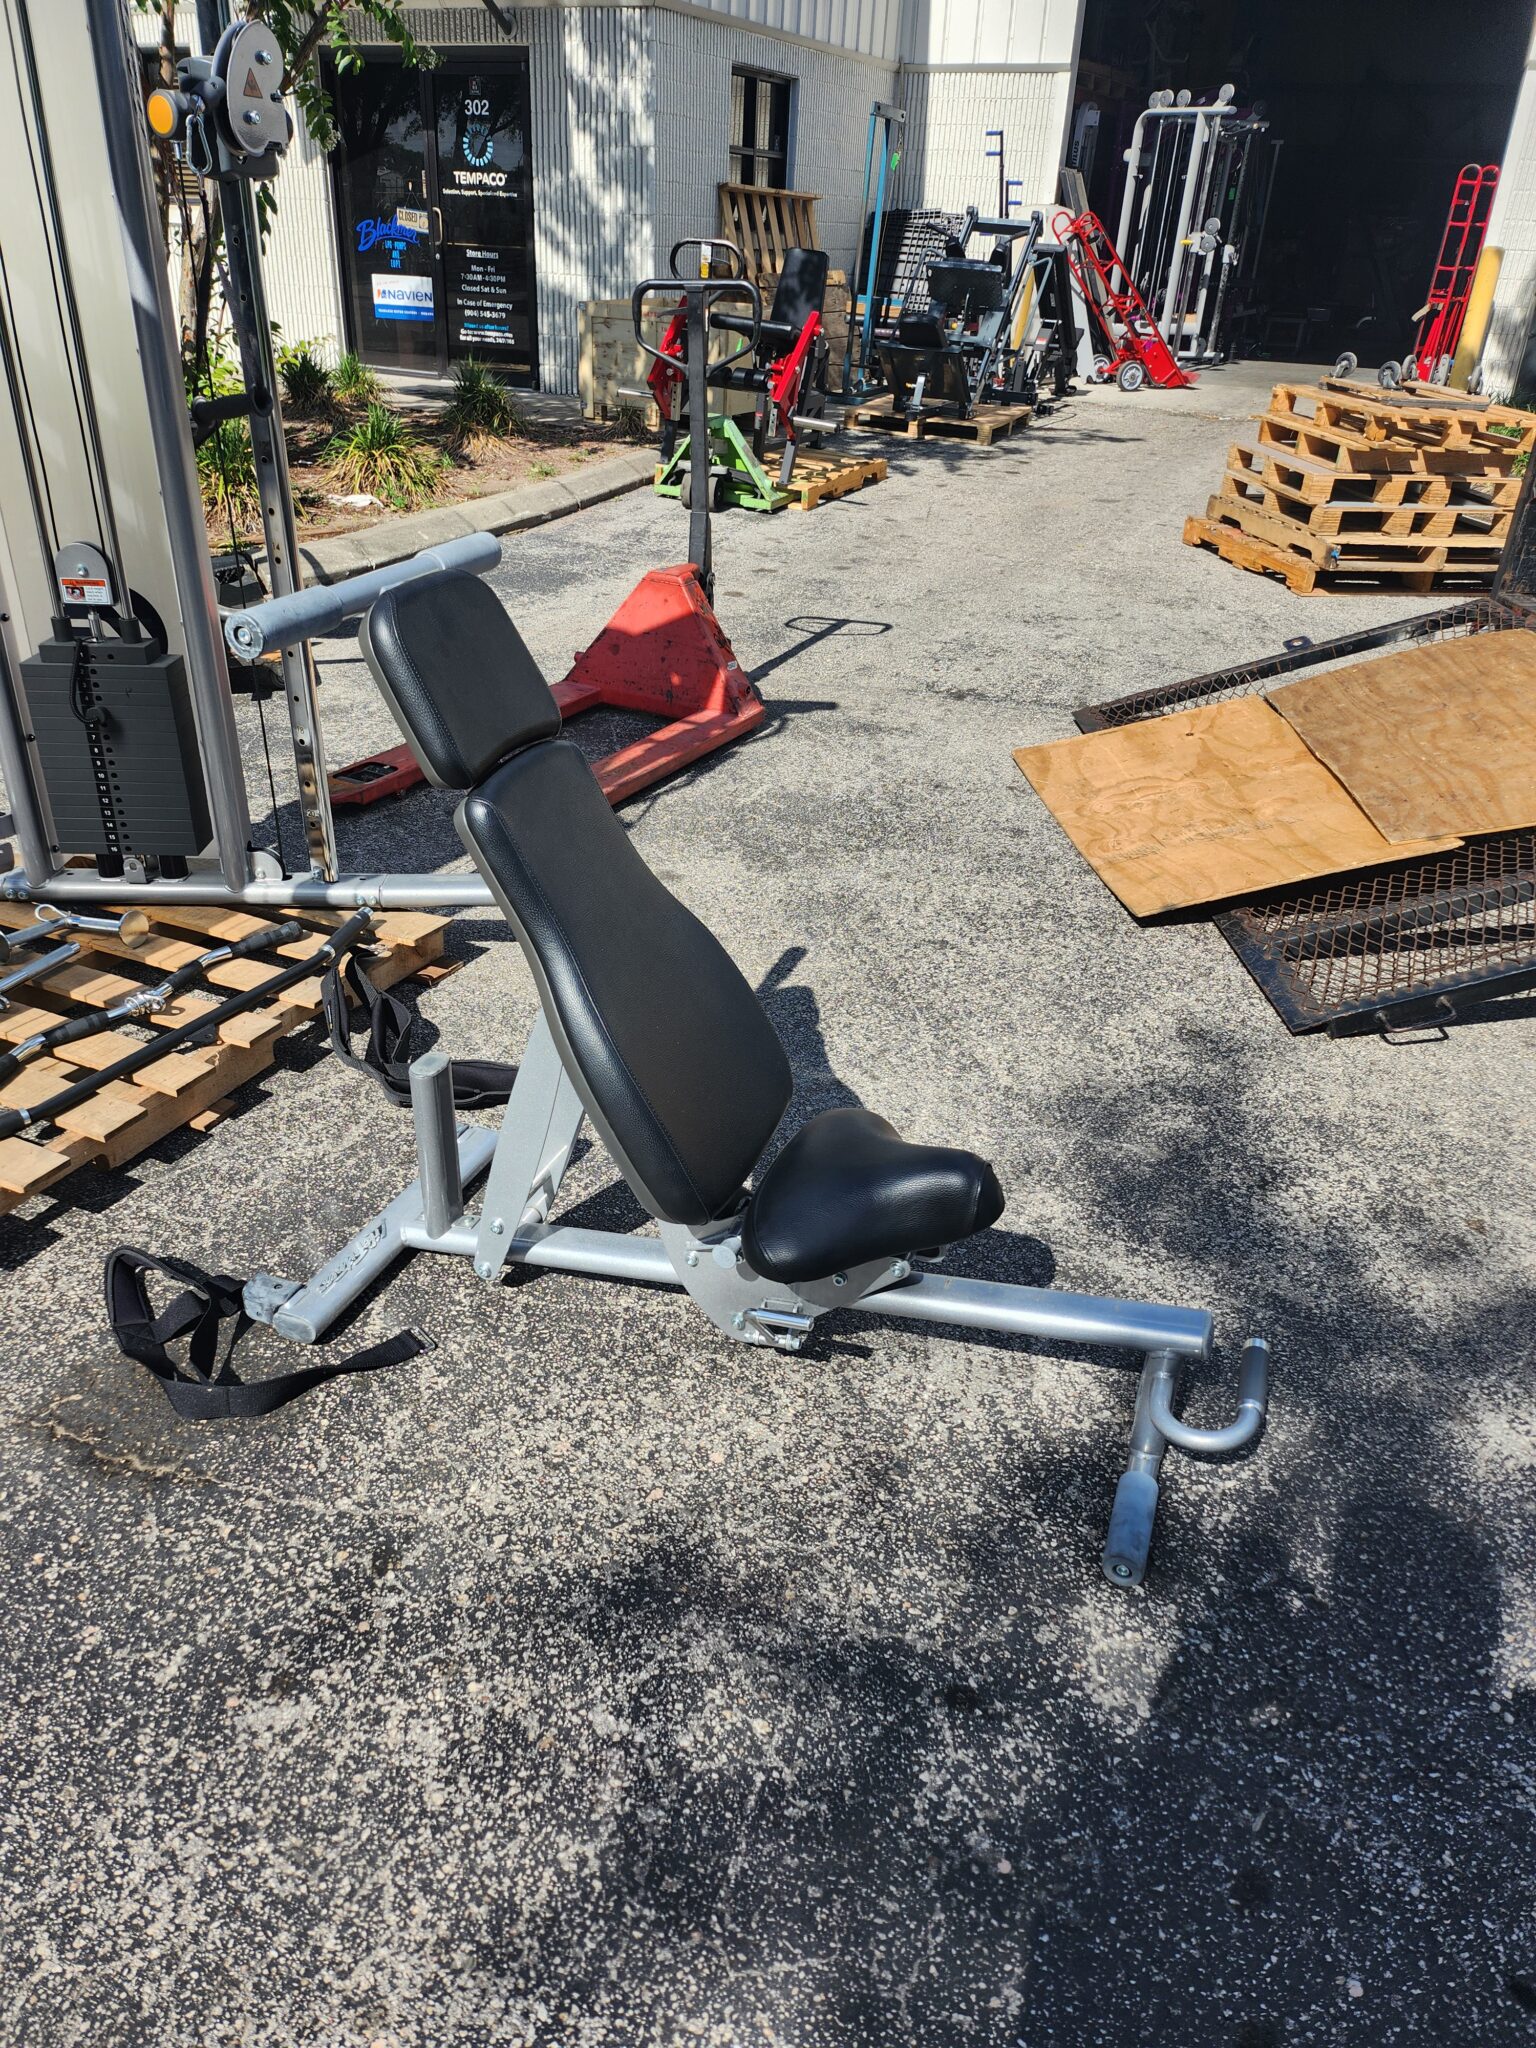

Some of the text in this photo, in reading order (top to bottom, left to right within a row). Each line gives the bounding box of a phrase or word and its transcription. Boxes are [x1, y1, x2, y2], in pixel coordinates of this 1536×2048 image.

[465, 100, 489, 115] 302
[453, 171, 506, 187] TEMPACO
[398, 210, 418, 222] CLOSED
[356, 214, 420, 251] Blackmer
[466, 249, 499, 259] Store Hours
[462, 284, 480, 292] Closed
[481, 285, 490, 293] Sat
[463, 298, 476, 307] Case
[476, 299, 482, 307] of
[482, 300, 513, 311] Emergency
